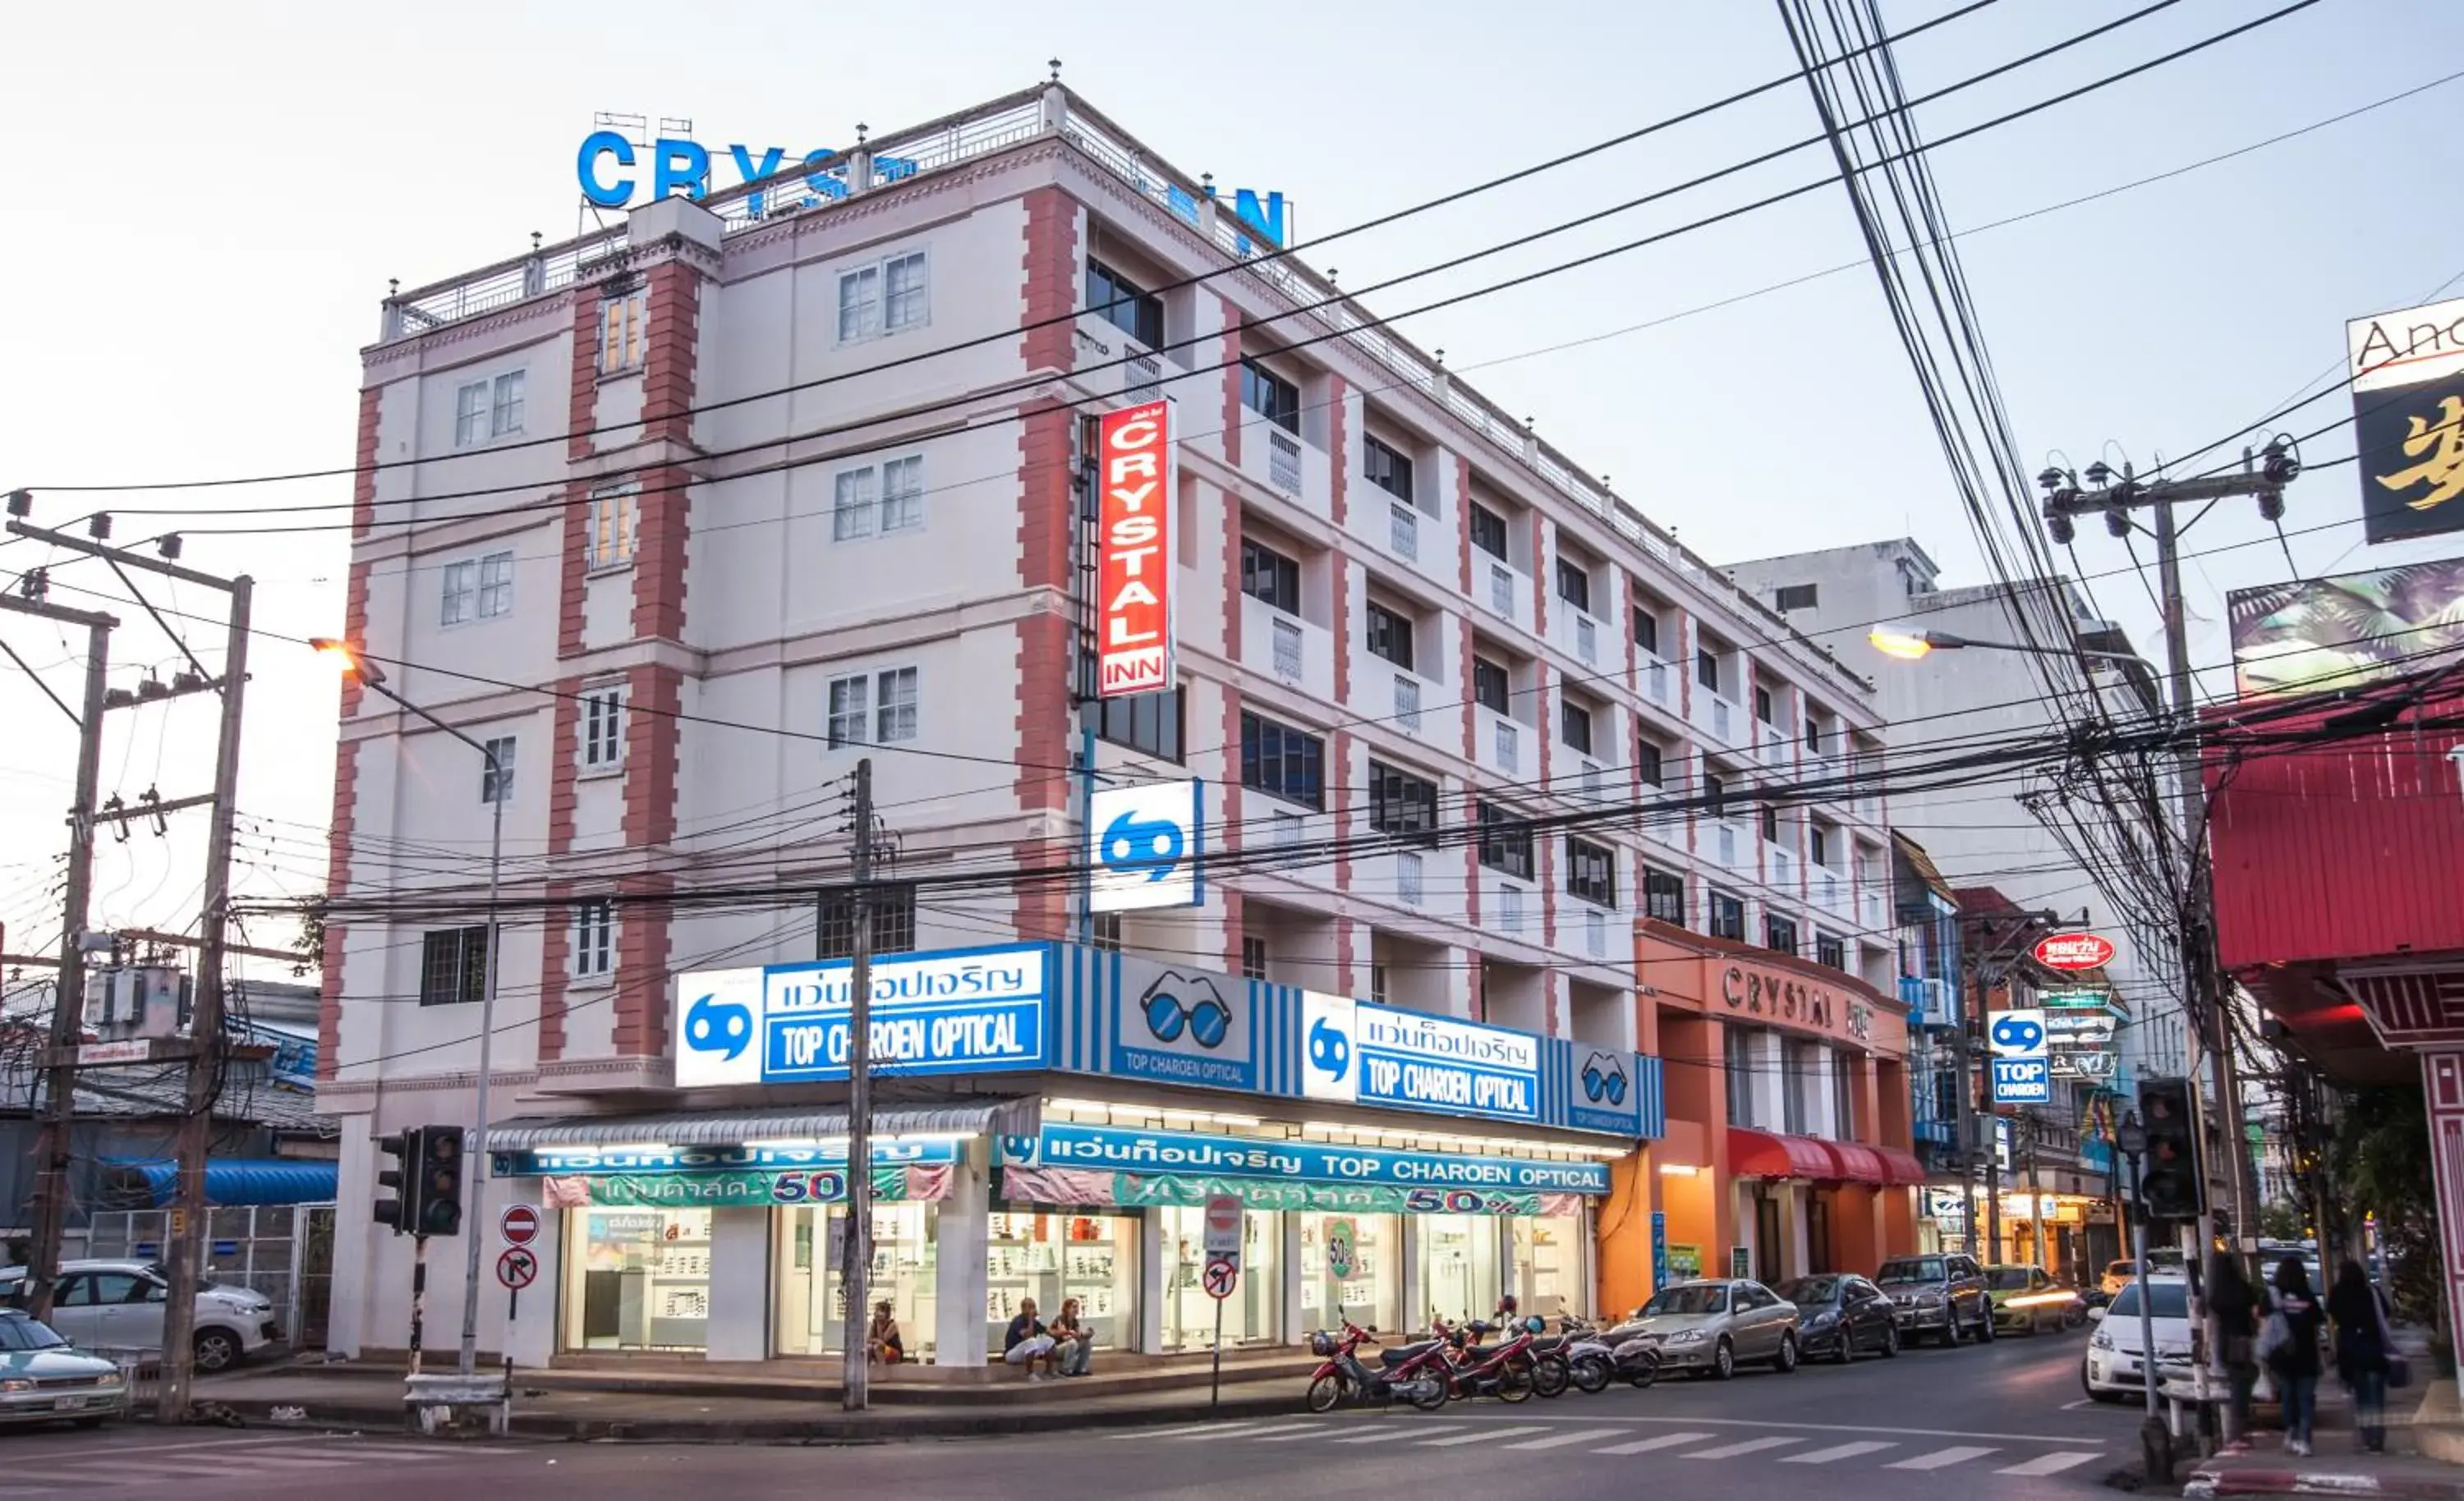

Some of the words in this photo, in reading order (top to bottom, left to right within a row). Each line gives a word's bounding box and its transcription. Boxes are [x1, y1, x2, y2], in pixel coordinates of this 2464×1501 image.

[1109, 421, 1158, 647] CRYSTAL
[1106, 656, 1161, 685] INN
[784, 966, 1023, 1007] แว่นอปเจริญ
[1723, 966, 1833, 1028] CRYSTAL
[781, 1026, 823, 1066] TOP
[827, 1018, 926, 1064] CHROEN
[931, 1012, 1024, 1058] OPTICAL
[1126, 1052, 1148, 1071] TOP
[1369, 1015, 1528, 1065] แว่นท็อปเจริญ
[1368, 1058, 1400, 1096] TOP
[1403, 1063, 1472, 1105] CHAROEN
[1474, 1075, 1530, 1111] OPTICAL
[1997, 1063, 2044, 1081] TOP
[1050, 1136, 1302, 1173] แว่นท็อปเจริญ
[1322, 1154, 1381, 1177] TOP
[1392, 1161, 1511, 1184] CHAROEN
[1519, 1168, 1605, 1188] OPTICAL
[1404, 1187, 1519, 1215] 50%
